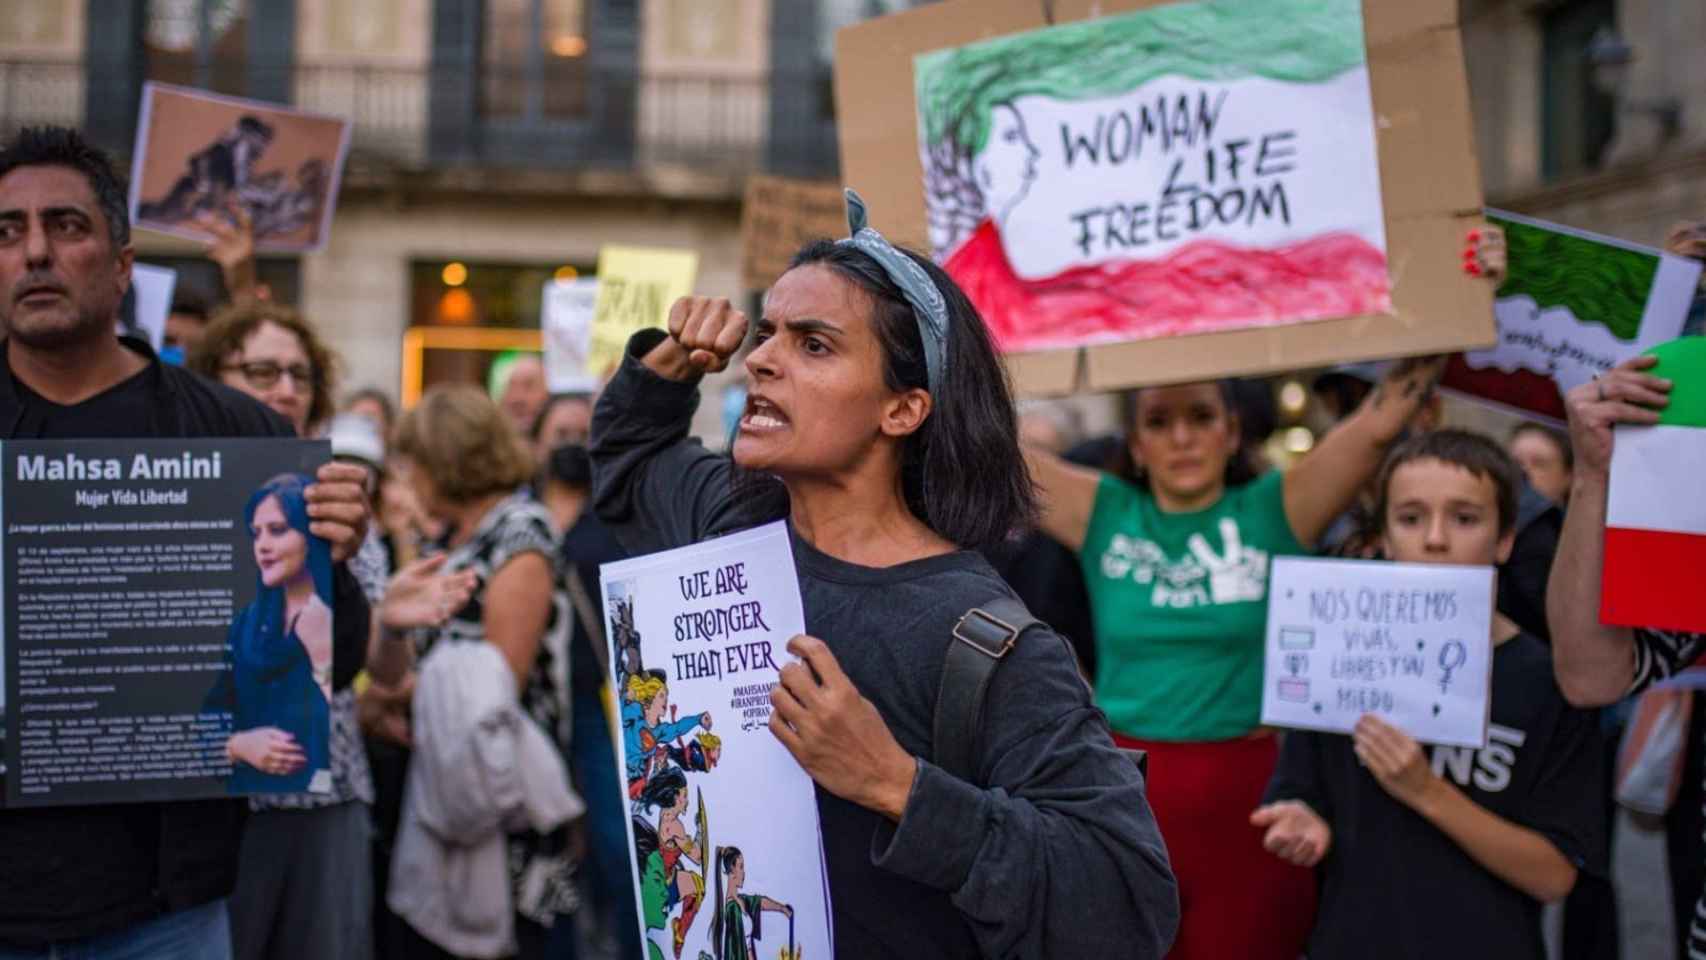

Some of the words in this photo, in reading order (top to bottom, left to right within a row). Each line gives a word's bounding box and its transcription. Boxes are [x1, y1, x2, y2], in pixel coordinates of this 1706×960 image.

[1059, 89, 1229, 168] WOMAN
[1162, 131, 1297, 198] LIFE
[1069, 182, 1292, 256] FREEDOM
[16, 453, 122, 481] Mahsa
[129, 451, 222, 479] Amini
[75, 489, 109, 509] Mujer
[111, 489, 138, 505] Vida
[139, 488, 189, 505] Libertad
[679, 570, 712, 601] WE
[715, 561, 748, 595] ARE
[673, 600, 771, 642] STRONGER
[1309, 587, 1350, 624] NOS
[1356, 586, 1458, 624] QUEREMOS
[672, 648, 722, 681] THAN
[725, 640, 781, 674] EVER
